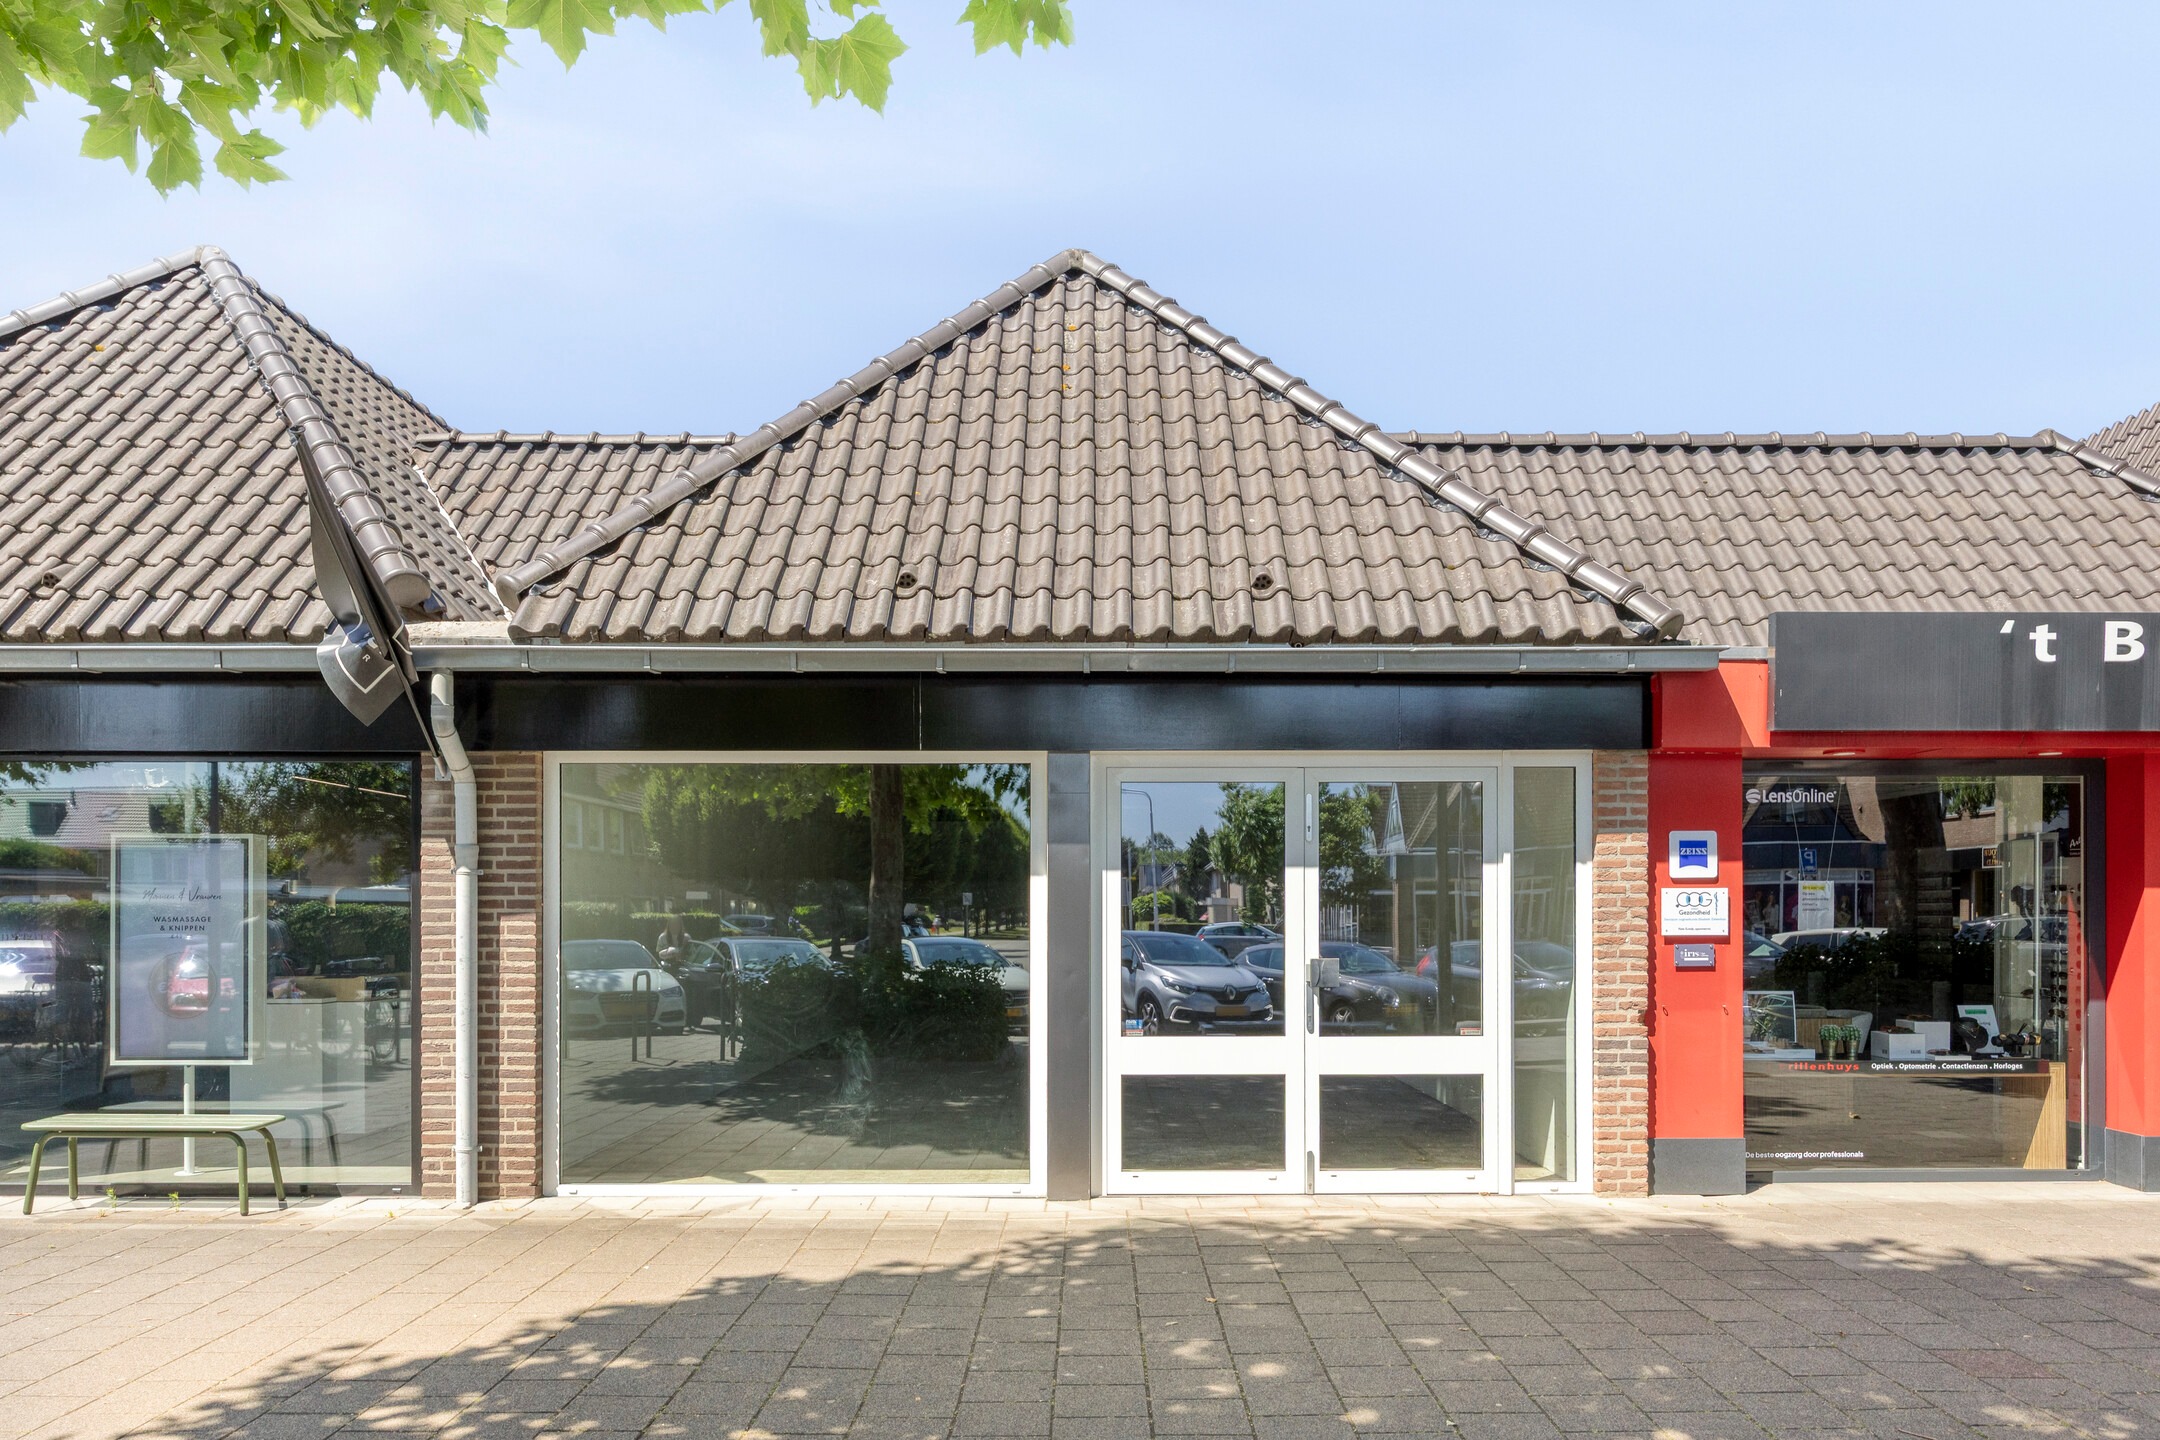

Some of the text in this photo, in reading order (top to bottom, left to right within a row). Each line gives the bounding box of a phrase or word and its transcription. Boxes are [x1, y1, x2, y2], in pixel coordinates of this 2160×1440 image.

[2104, 620, 2145, 662] B
[1762, 788, 1835, 803] LensOnline
[1680, 847, 1707, 856] ZEISS
[1684, 948, 1700, 957] iris
[1785, 1061, 1860, 1072] rillenhuys
[1871, 1062, 2023, 1071] Optiek Optometrie Contactlenzen Horloges
[1745, 1151, 1755, 1159] De
[1755, 1151, 1775, 1159] beste
[1774, 1152, 1803, 1160] oogzorg
[1819, 1150, 1864, 1159] professionals
